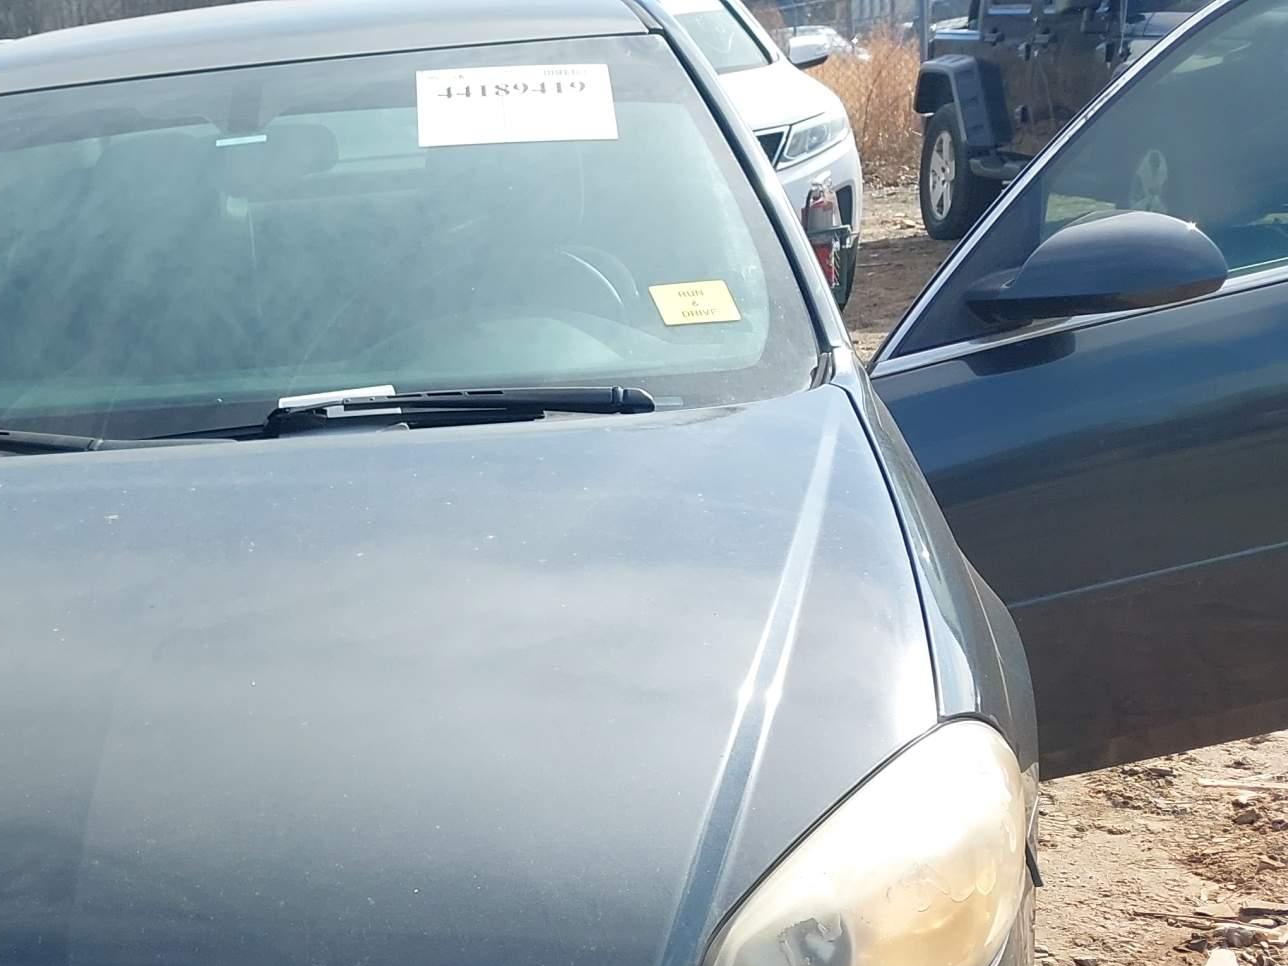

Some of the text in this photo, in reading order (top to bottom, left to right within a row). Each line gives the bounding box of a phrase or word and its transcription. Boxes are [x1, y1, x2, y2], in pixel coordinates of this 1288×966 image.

[436, 80, 587, 99] 44189419
[677, 289, 705, 298] RUN
[681, 308, 717, 318] DRIVE
